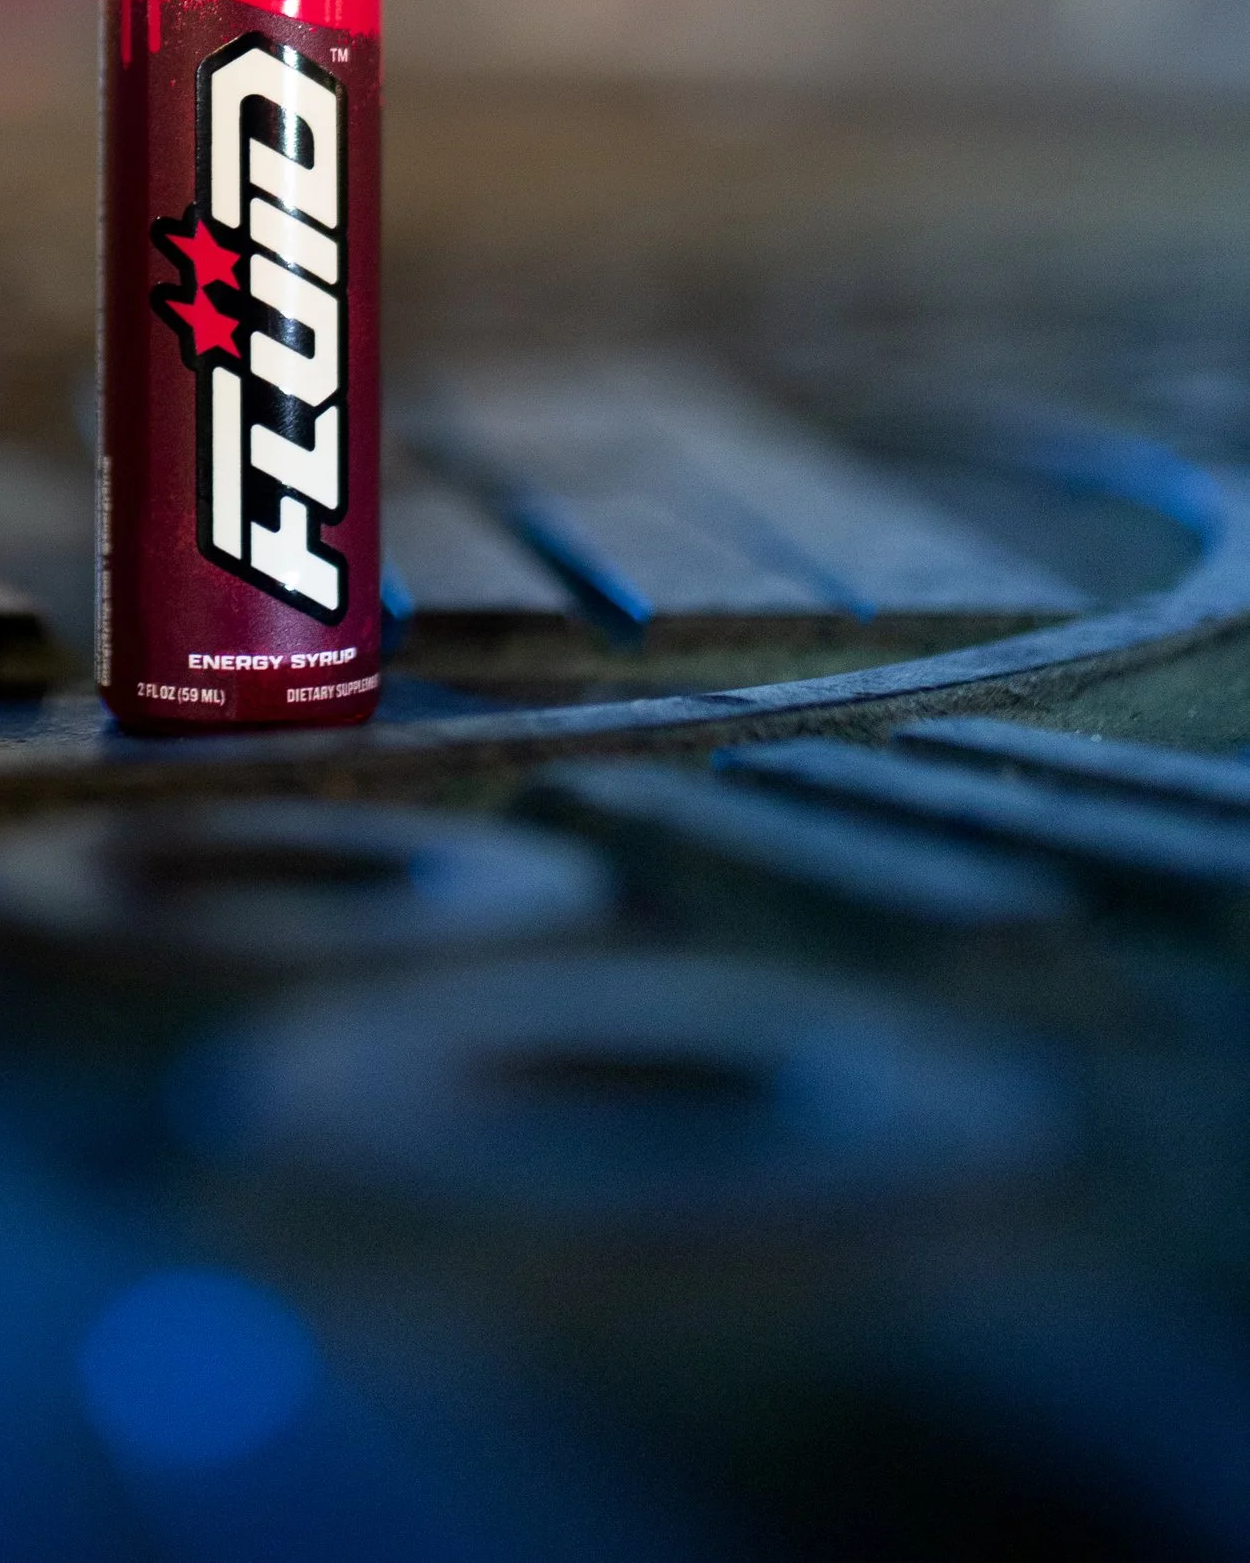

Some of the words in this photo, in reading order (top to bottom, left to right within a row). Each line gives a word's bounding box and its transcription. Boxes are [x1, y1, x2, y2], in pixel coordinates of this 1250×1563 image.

[330, 47, 349, 64] TM
[206, 42, 343, 616] FLUID
[188, 653, 284, 671] ENERGY
[290, 646, 358, 670] SYRUP
[137, 682, 145, 697] 2
[146, 683, 159, 698] FL
[159, 685, 175, 701] OZ
[177, 687, 199, 705] (59
[200, 688, 226, 706] ML)
[287, 684, 335, 703] DIETARY
